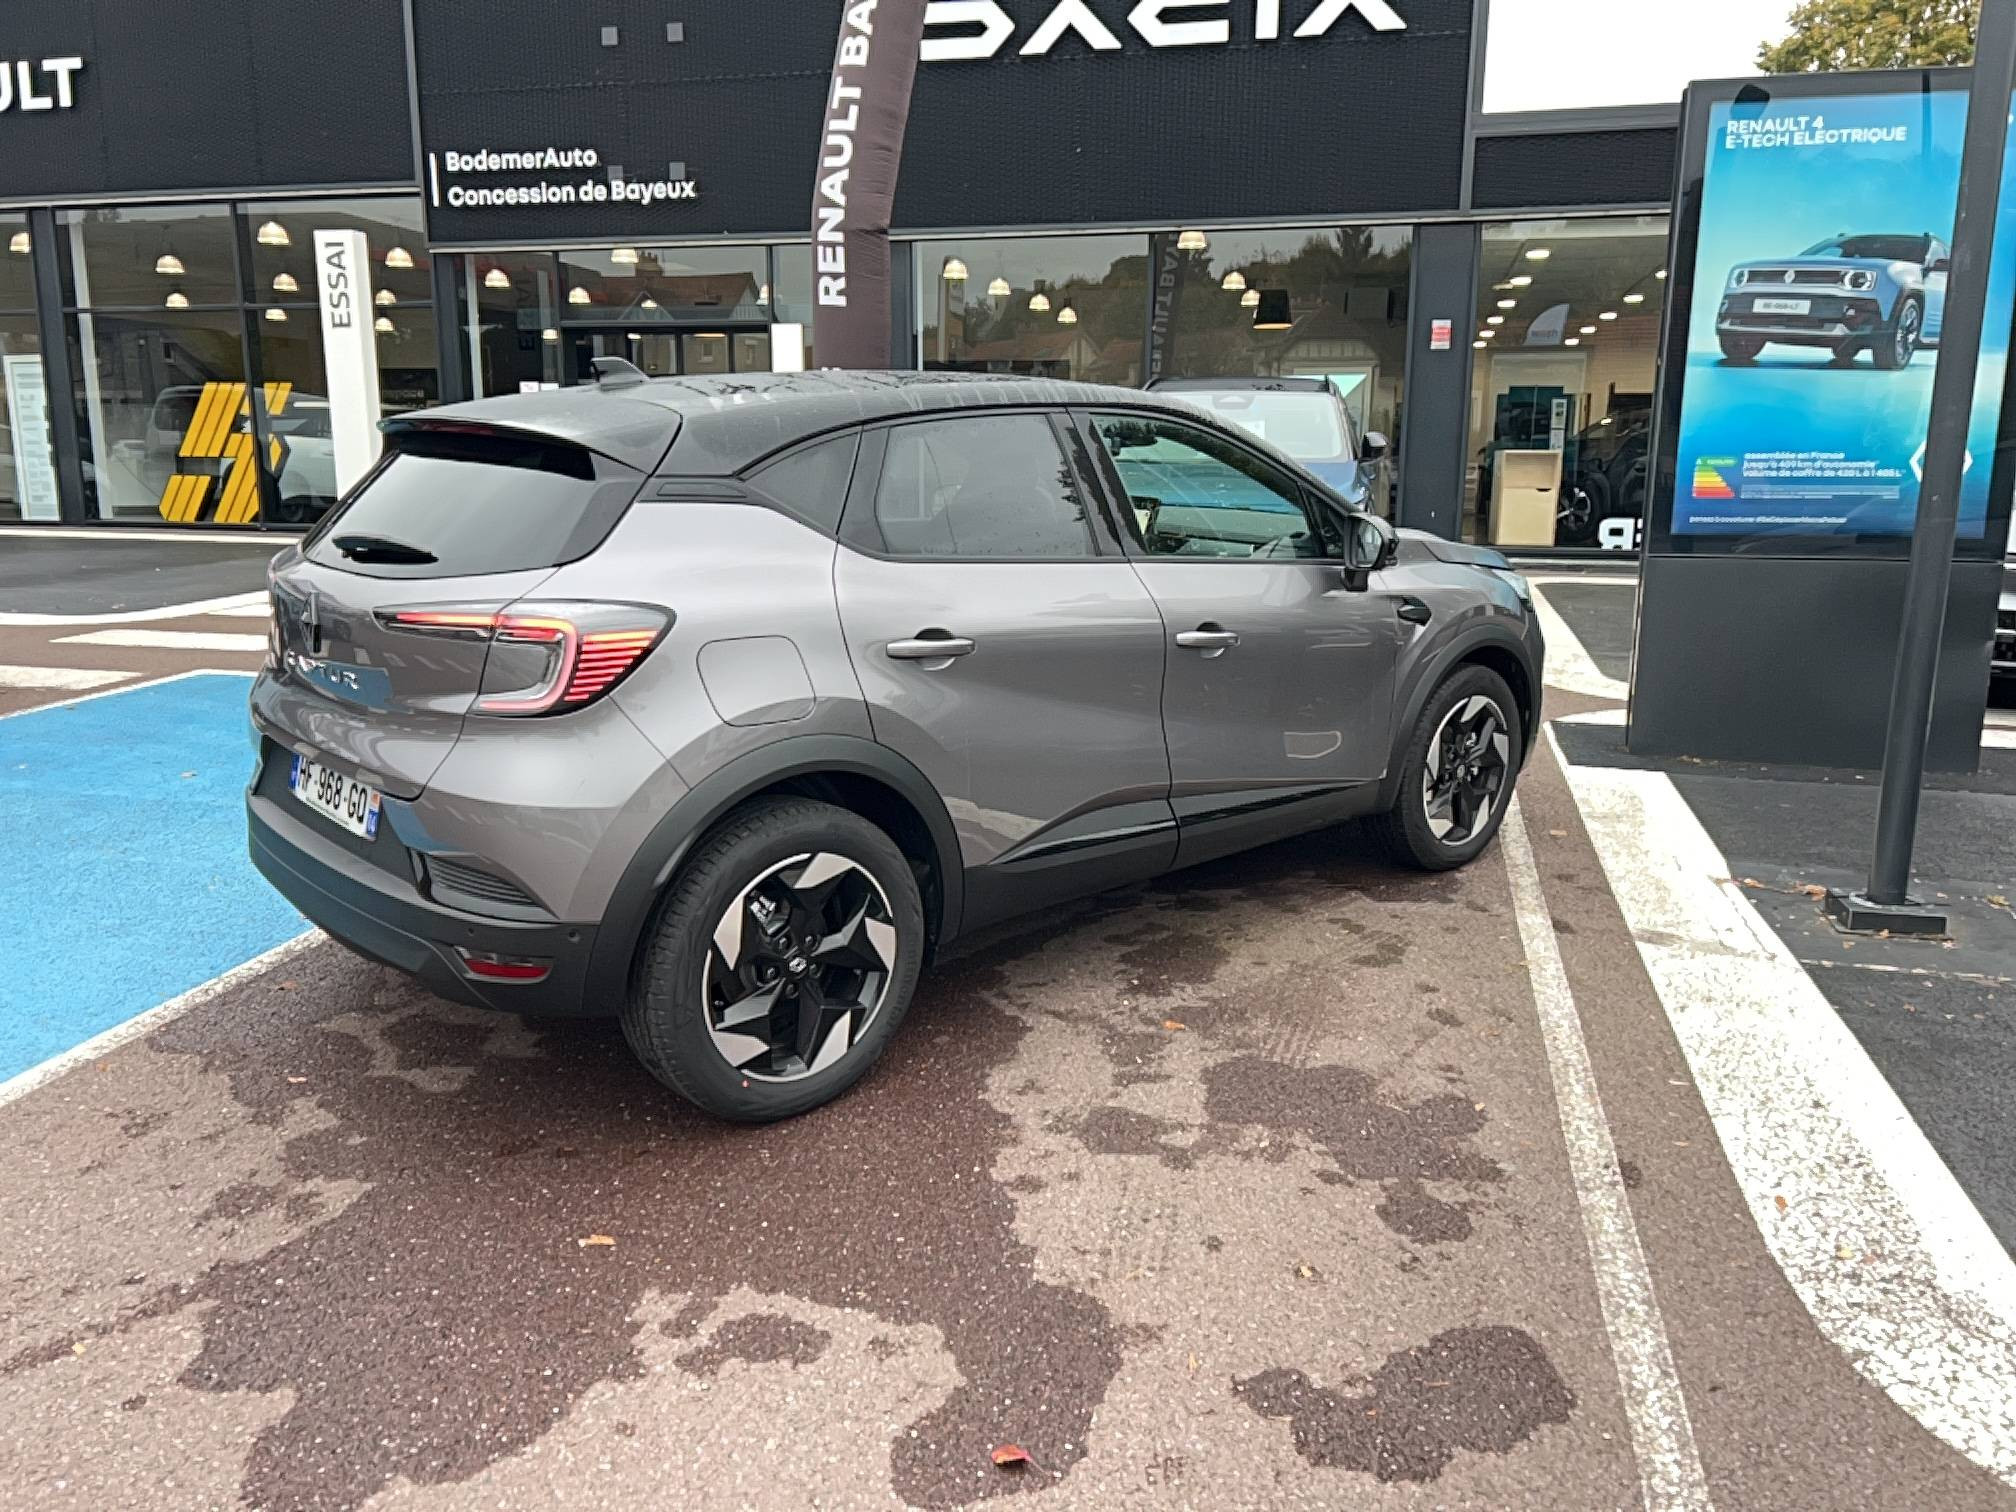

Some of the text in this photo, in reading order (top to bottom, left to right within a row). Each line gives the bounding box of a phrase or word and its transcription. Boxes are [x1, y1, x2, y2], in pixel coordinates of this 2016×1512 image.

[1727, 115, 1824, 134] RENAULT 4
[817, 0, 879, 307] RENAULT BA
[1725, 132, 1790, 149] E-TECH
[445, 147, 598, 172] BodemerAuto
[447, 179, 697, 207] Concession de Bayeux
[324, 241, 352, 329] ESSAI
